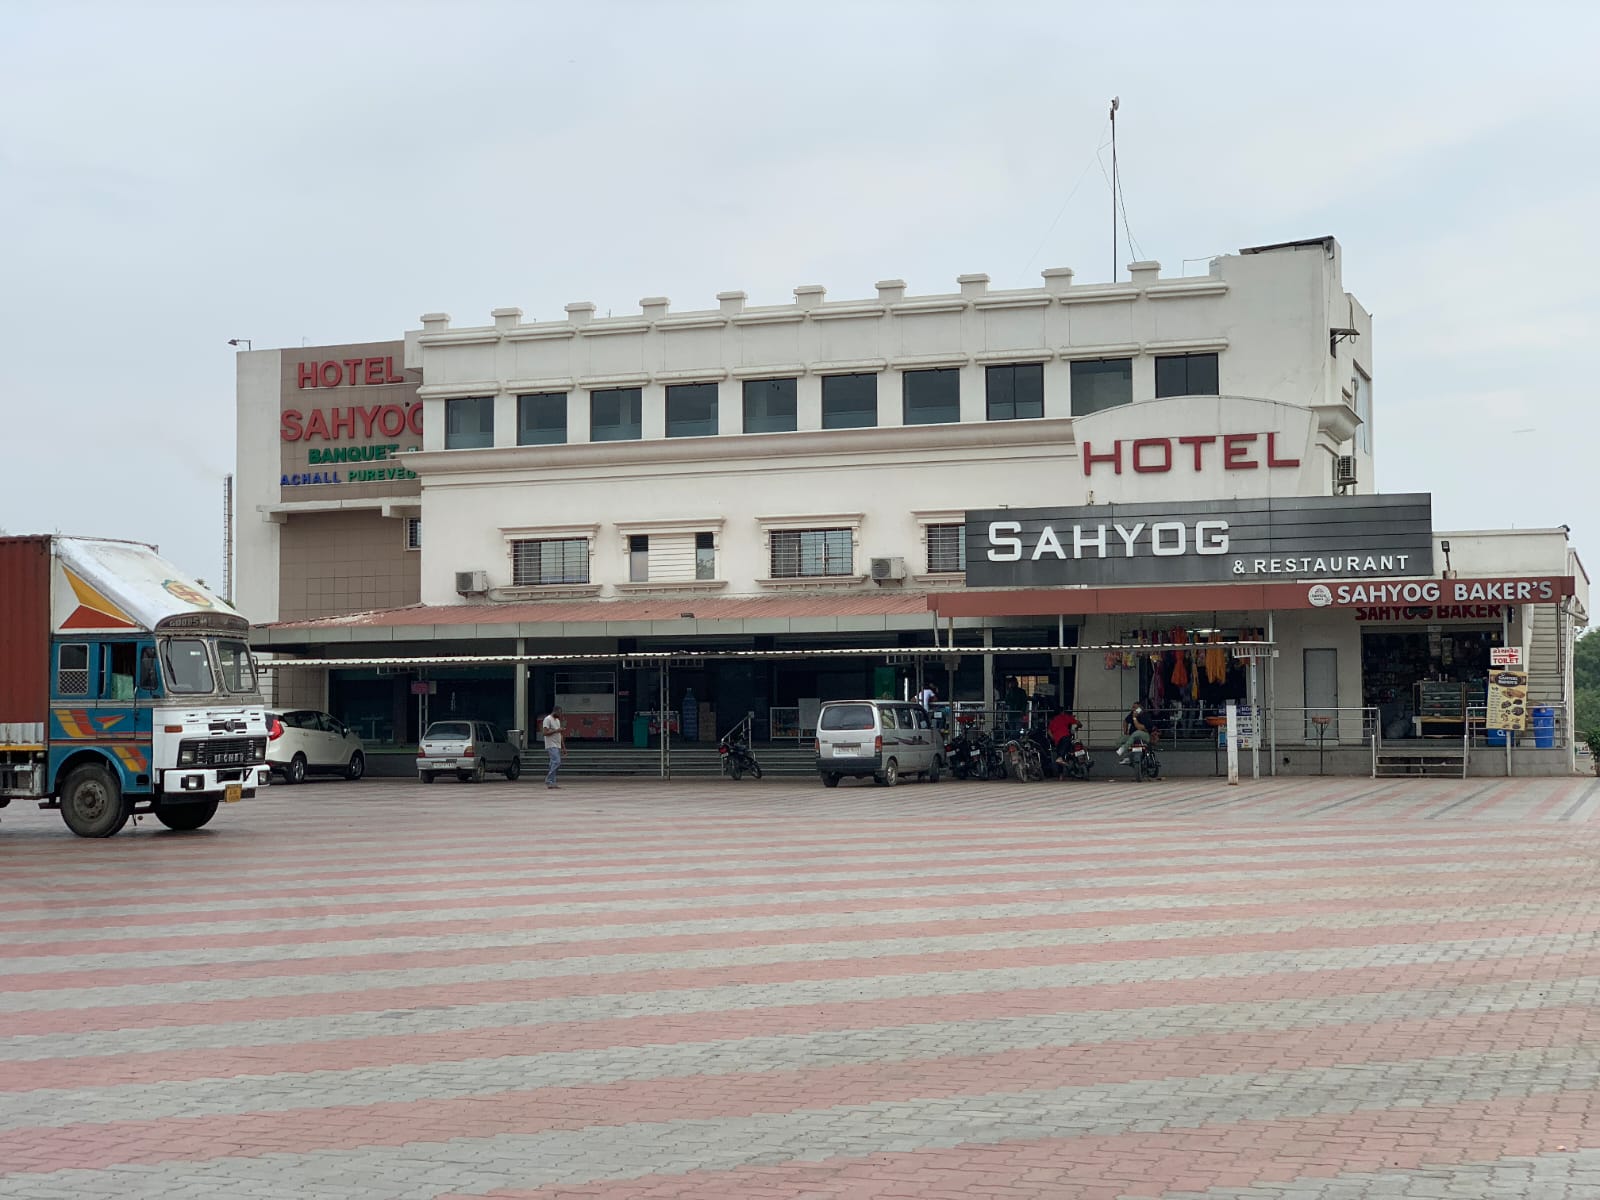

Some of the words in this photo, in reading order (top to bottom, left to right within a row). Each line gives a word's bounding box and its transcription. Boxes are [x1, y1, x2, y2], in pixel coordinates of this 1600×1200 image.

[298, 356, 405, 388] HOTEL
[308, 444, 399, 464] BANQUET
[1083, 432, 1300, 476] HOTEL
[987, 520, 1229, 562] SAHYOG
[1233, 560, 1245, 574] &
[1254, 555, 1408, 573] RESTAURANT
[1337, 583, 1440, 604] SAHYOG
[1454, 581, 1553, 601] BAKER'S
